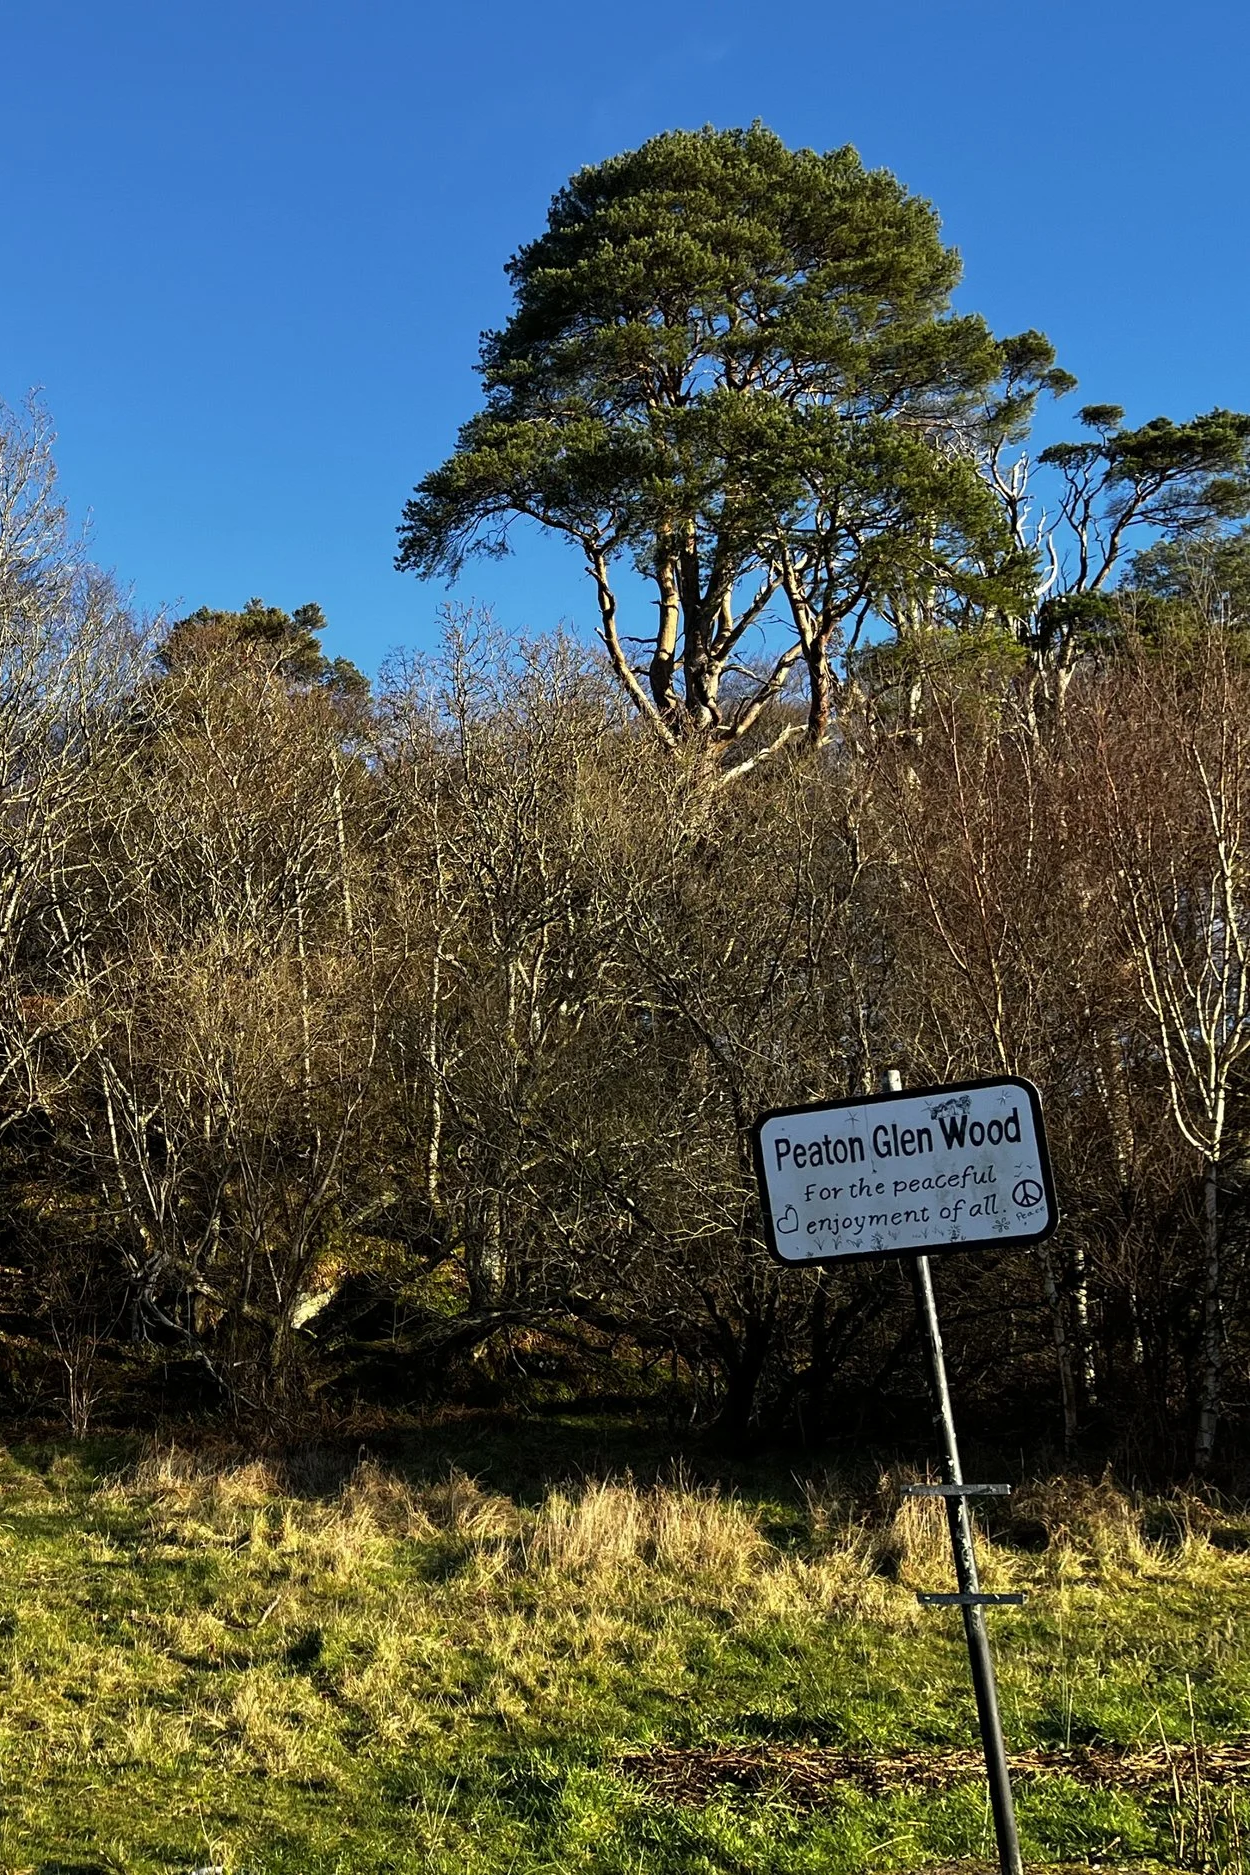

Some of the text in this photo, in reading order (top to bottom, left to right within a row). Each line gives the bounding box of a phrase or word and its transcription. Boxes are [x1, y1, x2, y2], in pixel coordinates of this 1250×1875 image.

[774, 1107, 1022, 1172] Peaton Glen Wood
[804, 1164, 997, 1202] For the peaceful
[806, 1206, 930, 1235] enjoyment
[940, 1199, 967, 1222] of
